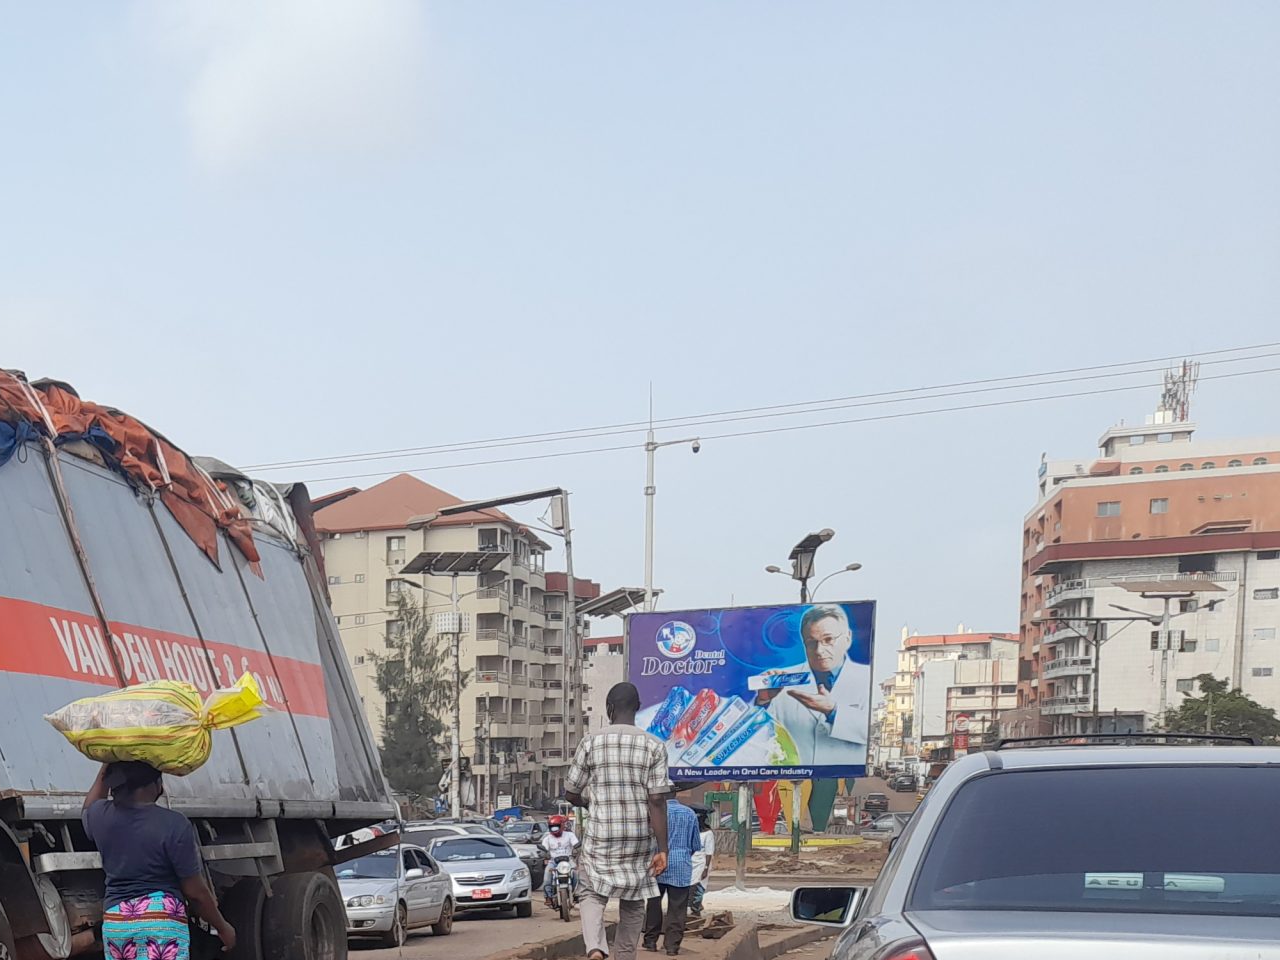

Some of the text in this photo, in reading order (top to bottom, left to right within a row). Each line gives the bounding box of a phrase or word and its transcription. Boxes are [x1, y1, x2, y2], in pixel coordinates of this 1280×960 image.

[49, 617, 114, 678] VAN
[113, 632, 160, 682] DEN
[695, 649, 725, 659] Dental
[641, 656, 718, 676] Doctor
[704, 768, 730, 776] Leader
[780, 767, 814, 776] Industry
